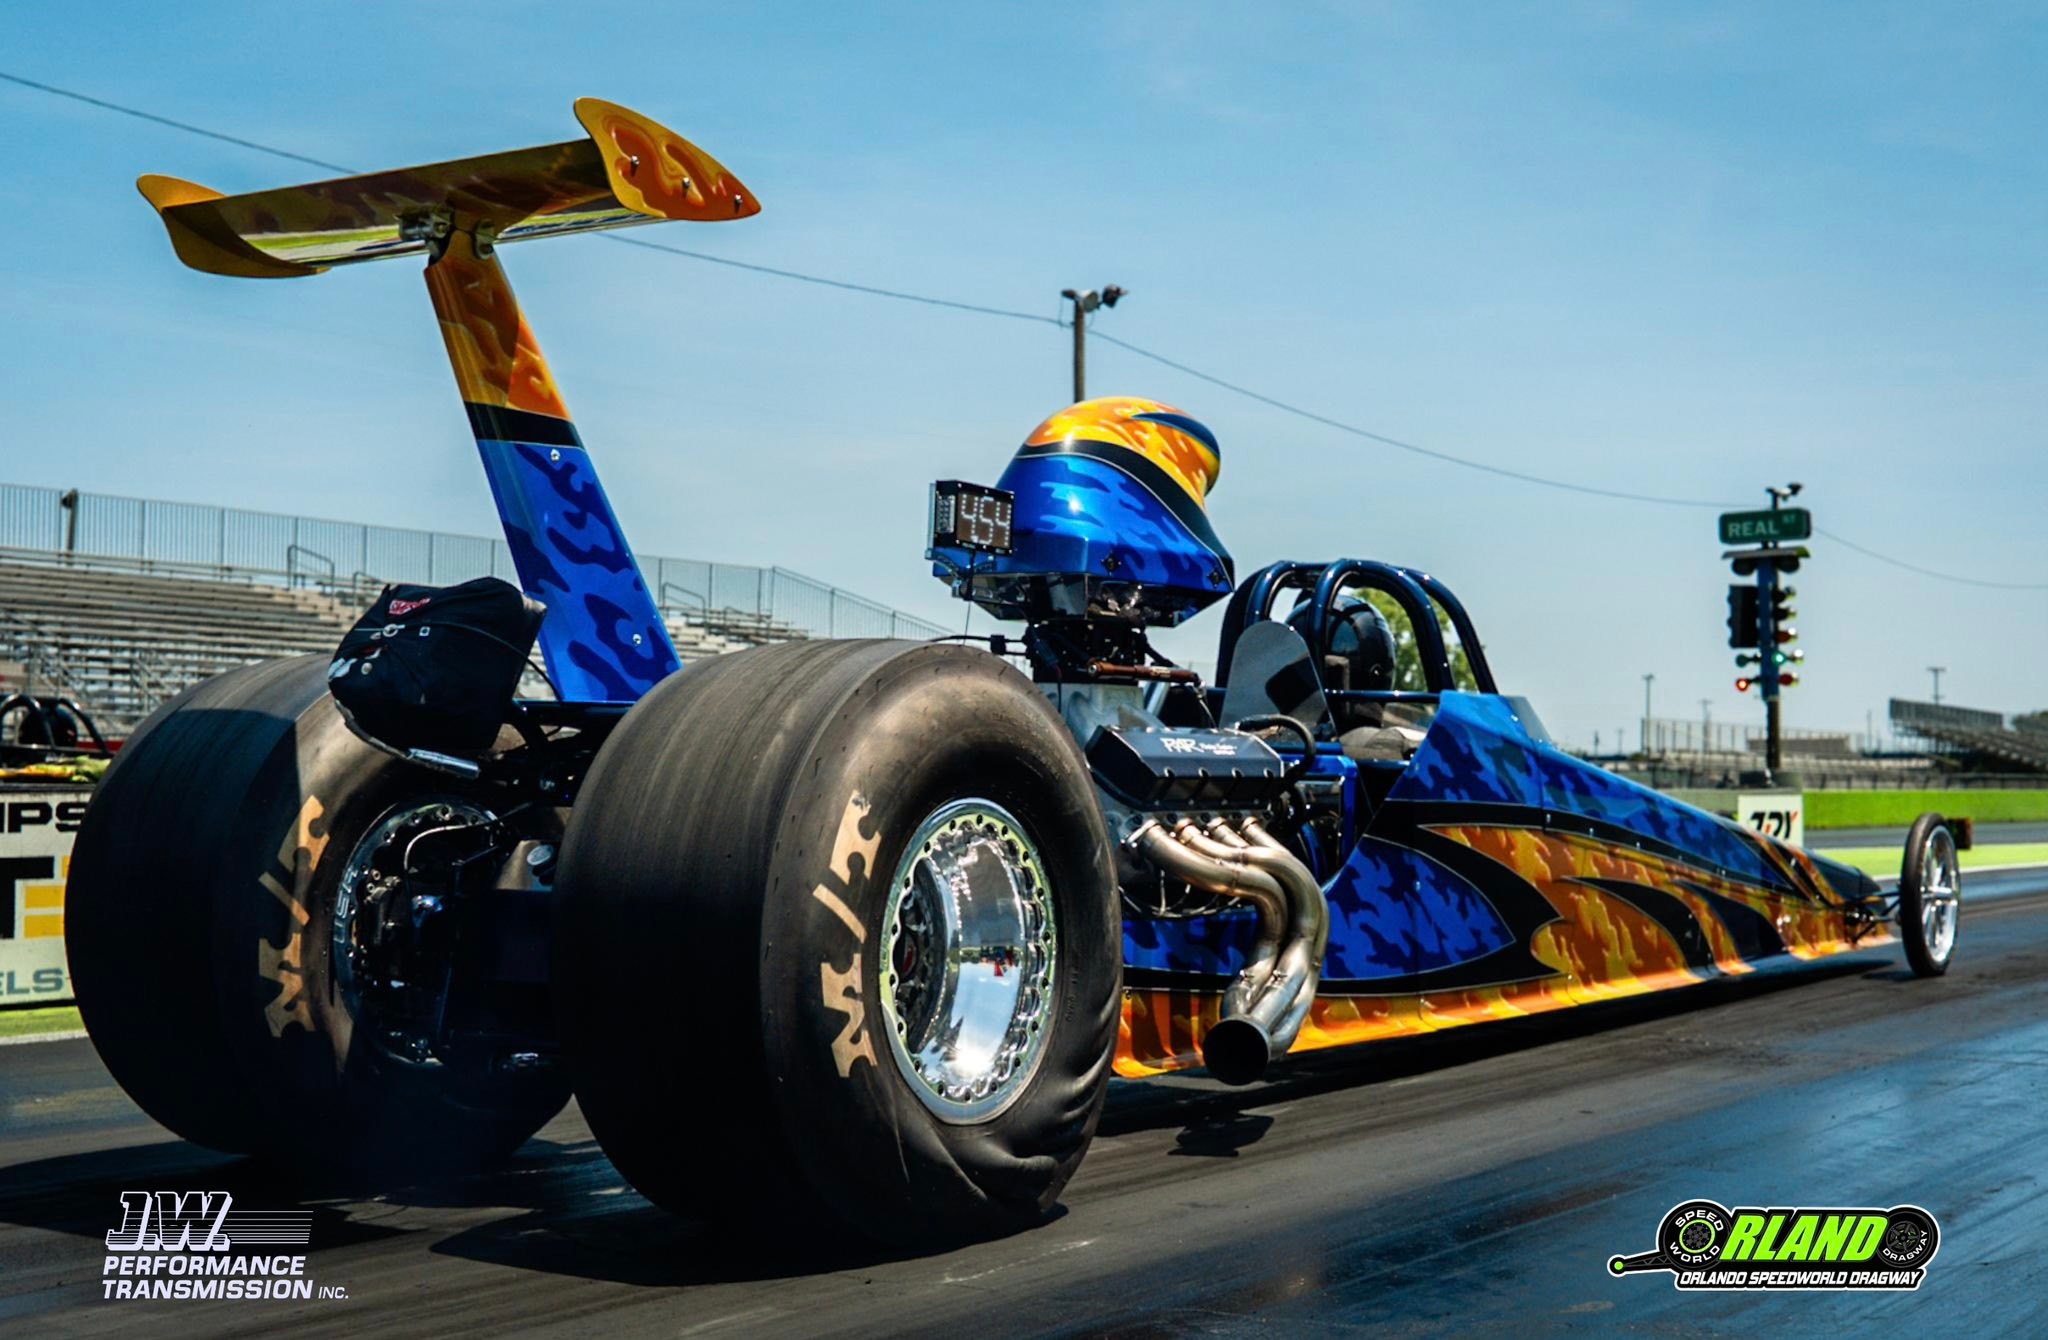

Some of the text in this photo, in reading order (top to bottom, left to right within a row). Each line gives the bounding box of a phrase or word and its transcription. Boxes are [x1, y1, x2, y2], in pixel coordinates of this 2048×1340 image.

[1727, 519, 1779, 538] REAL
[0, 801, 87, 834] PS
[0, 968, 65, 996] LS
